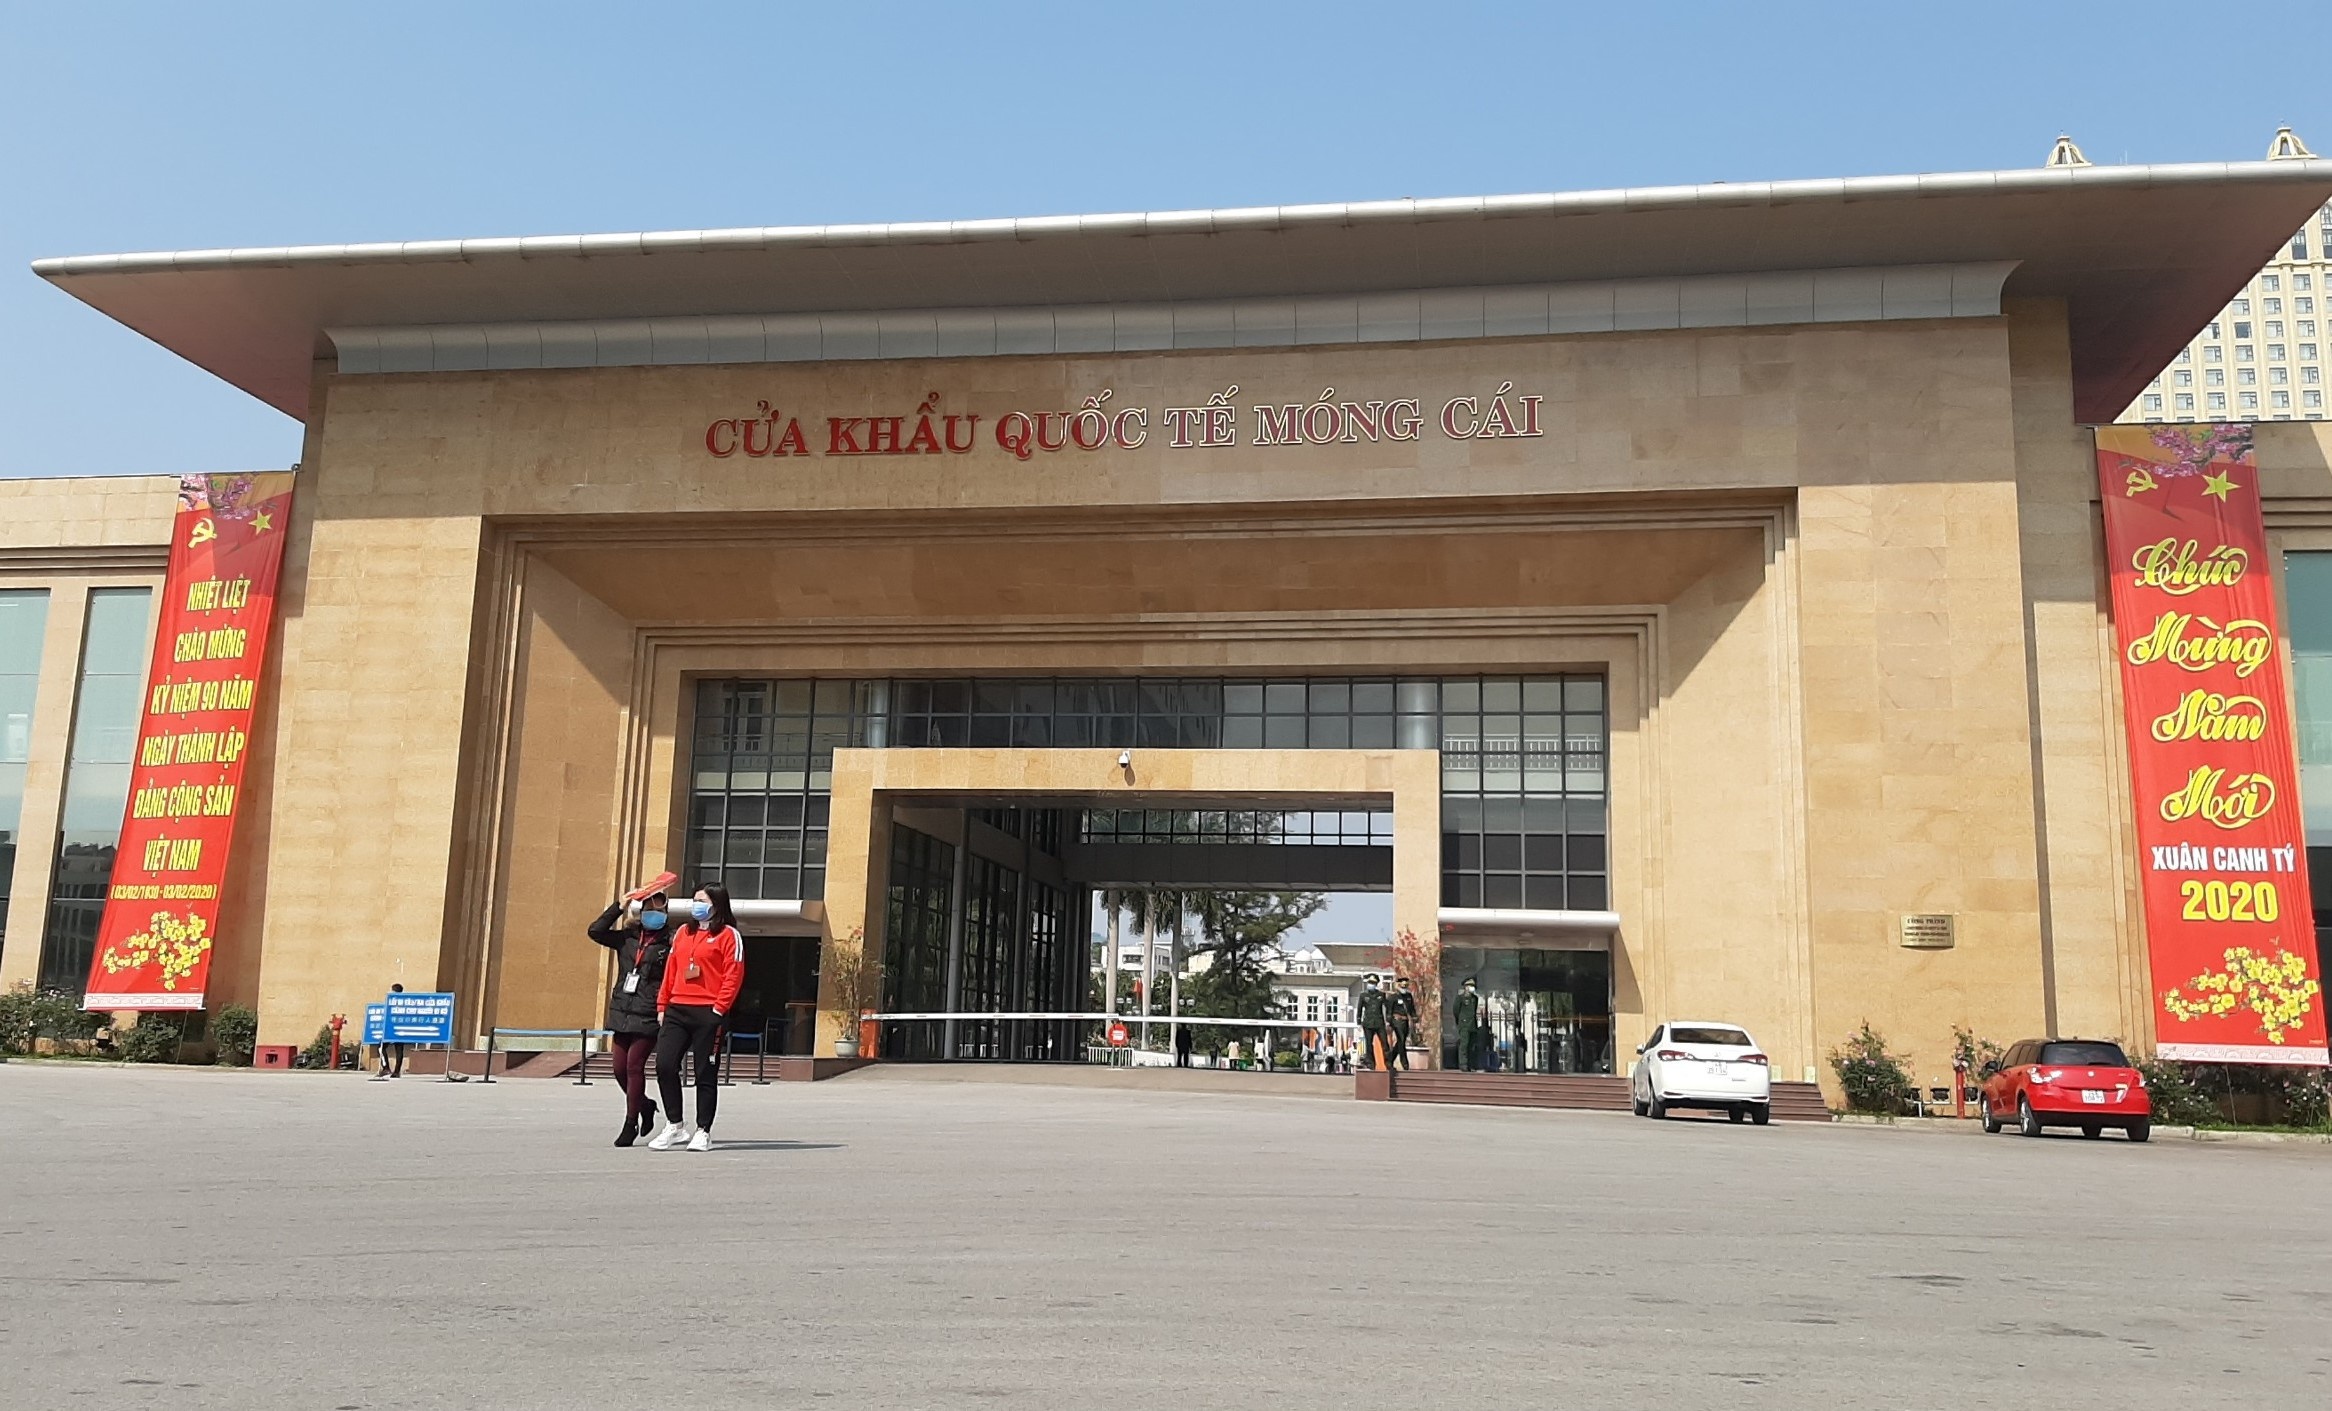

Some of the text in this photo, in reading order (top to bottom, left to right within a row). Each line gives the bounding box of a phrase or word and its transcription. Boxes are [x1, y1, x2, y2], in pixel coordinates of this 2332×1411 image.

[705, 381, 1544, 460] CỬA KHẨU QUỐC TẾ MÓNG CÁI
[2132, 537, 2248, 595] Chúc
[186, 573, 251, 616] NHIỆT LIỆT
[174, 624, 246, 663] CHÀO MỪNG
[2127, 610, 2272, 678] Mừng
[150, 674, 253, 719] KỶ NIỆM 90 NĂM
[2151, 688, 2267, 742] Năm
[141, 725, 245, 769] NGÀY THÀNH LẬP
[132, 774, 235, 823] ĐẢNG CỘNG SẢN
[2160, 765, 2276, 829] Mới
[143, 833, 202, 877] VIỆT NAM
[2151, 842, 2295, 872] XUÂN CANH TÝ
[2180, 879, 2279, 922] 2020
